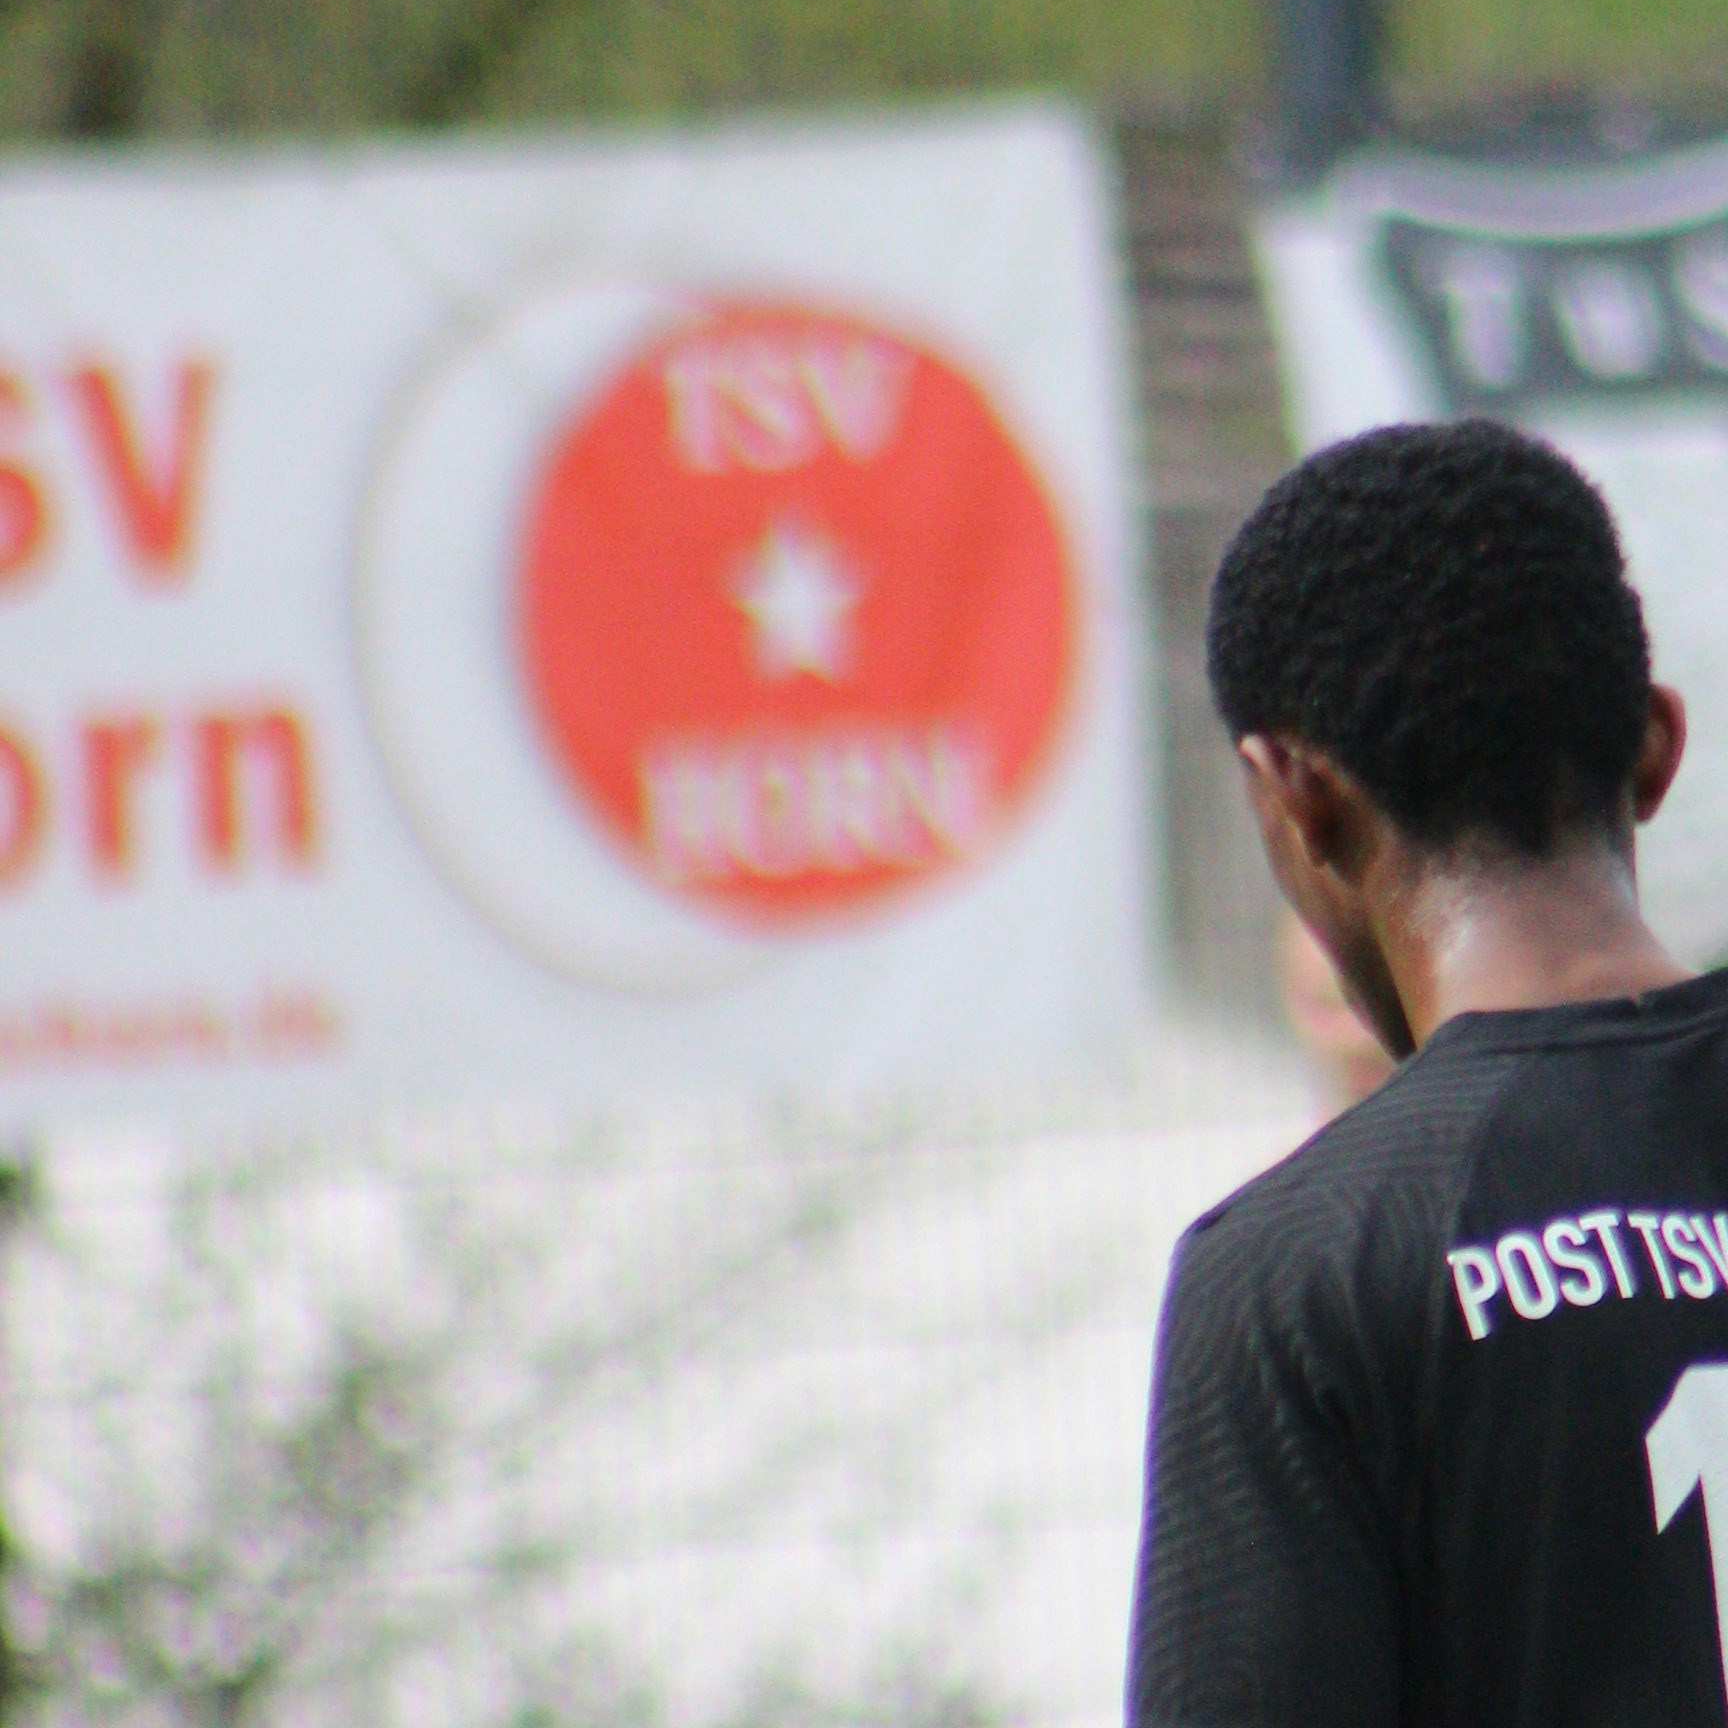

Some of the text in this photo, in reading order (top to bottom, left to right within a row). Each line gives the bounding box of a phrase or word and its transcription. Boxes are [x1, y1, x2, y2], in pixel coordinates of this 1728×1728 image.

[662, 334, 910, 472] TSV
[635, 727, 985, 877] HORN
[1447, 1212, 1634, 1341] POST
